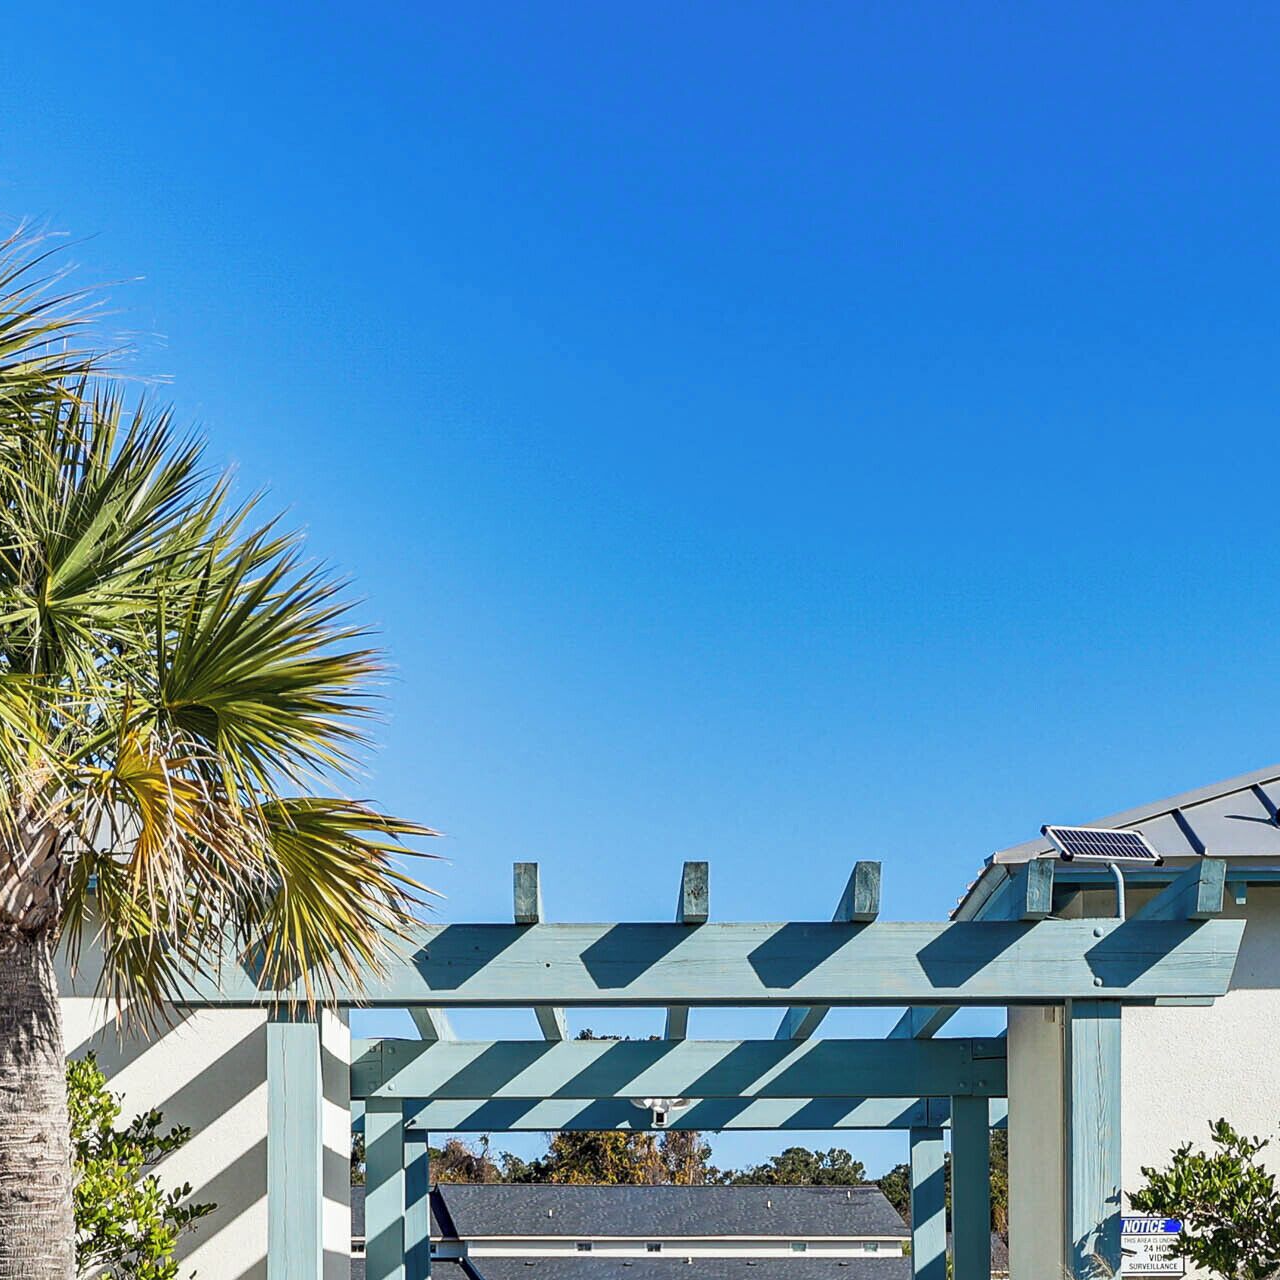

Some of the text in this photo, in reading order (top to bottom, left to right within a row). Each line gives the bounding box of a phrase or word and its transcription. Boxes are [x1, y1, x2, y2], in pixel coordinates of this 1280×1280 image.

[1122, 1220, 1166, 1233] NOTICE
[1143, 1244, 1153, 1252] 24
[1128, 1262, 1178, 1270] SURVEILLANCE
